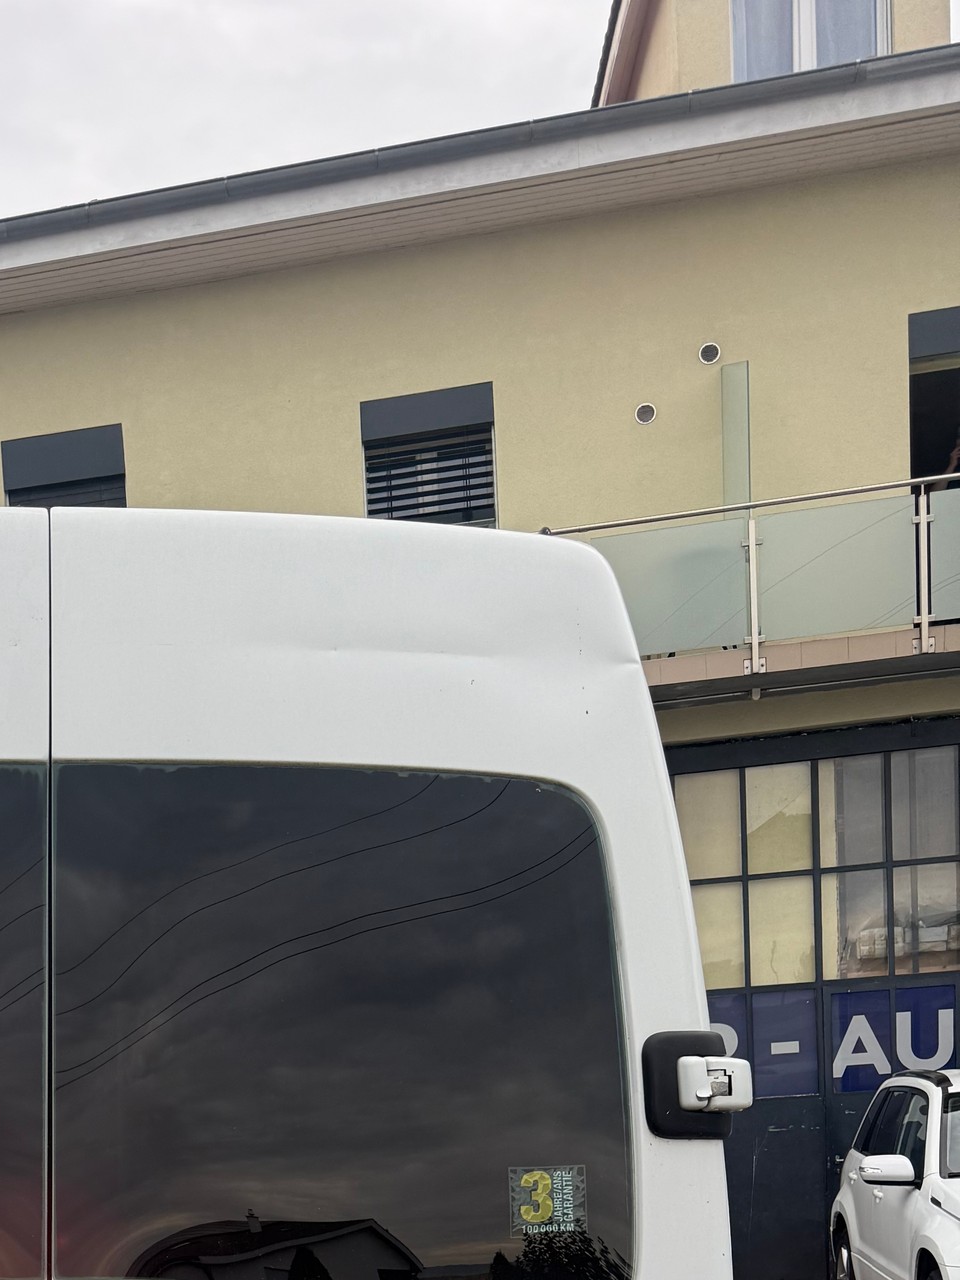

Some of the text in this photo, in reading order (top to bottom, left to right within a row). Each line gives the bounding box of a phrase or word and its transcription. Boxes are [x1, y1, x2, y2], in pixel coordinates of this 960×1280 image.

[832, 1008, 954, 1078] AU
[520, 1171, 553, 1223] 3
[553, 1171, 563, 1222] JAHRE/ANS
[563, 1171, 574, 1222] GARANTIE
[560, 1223, 574, 1232] KM
